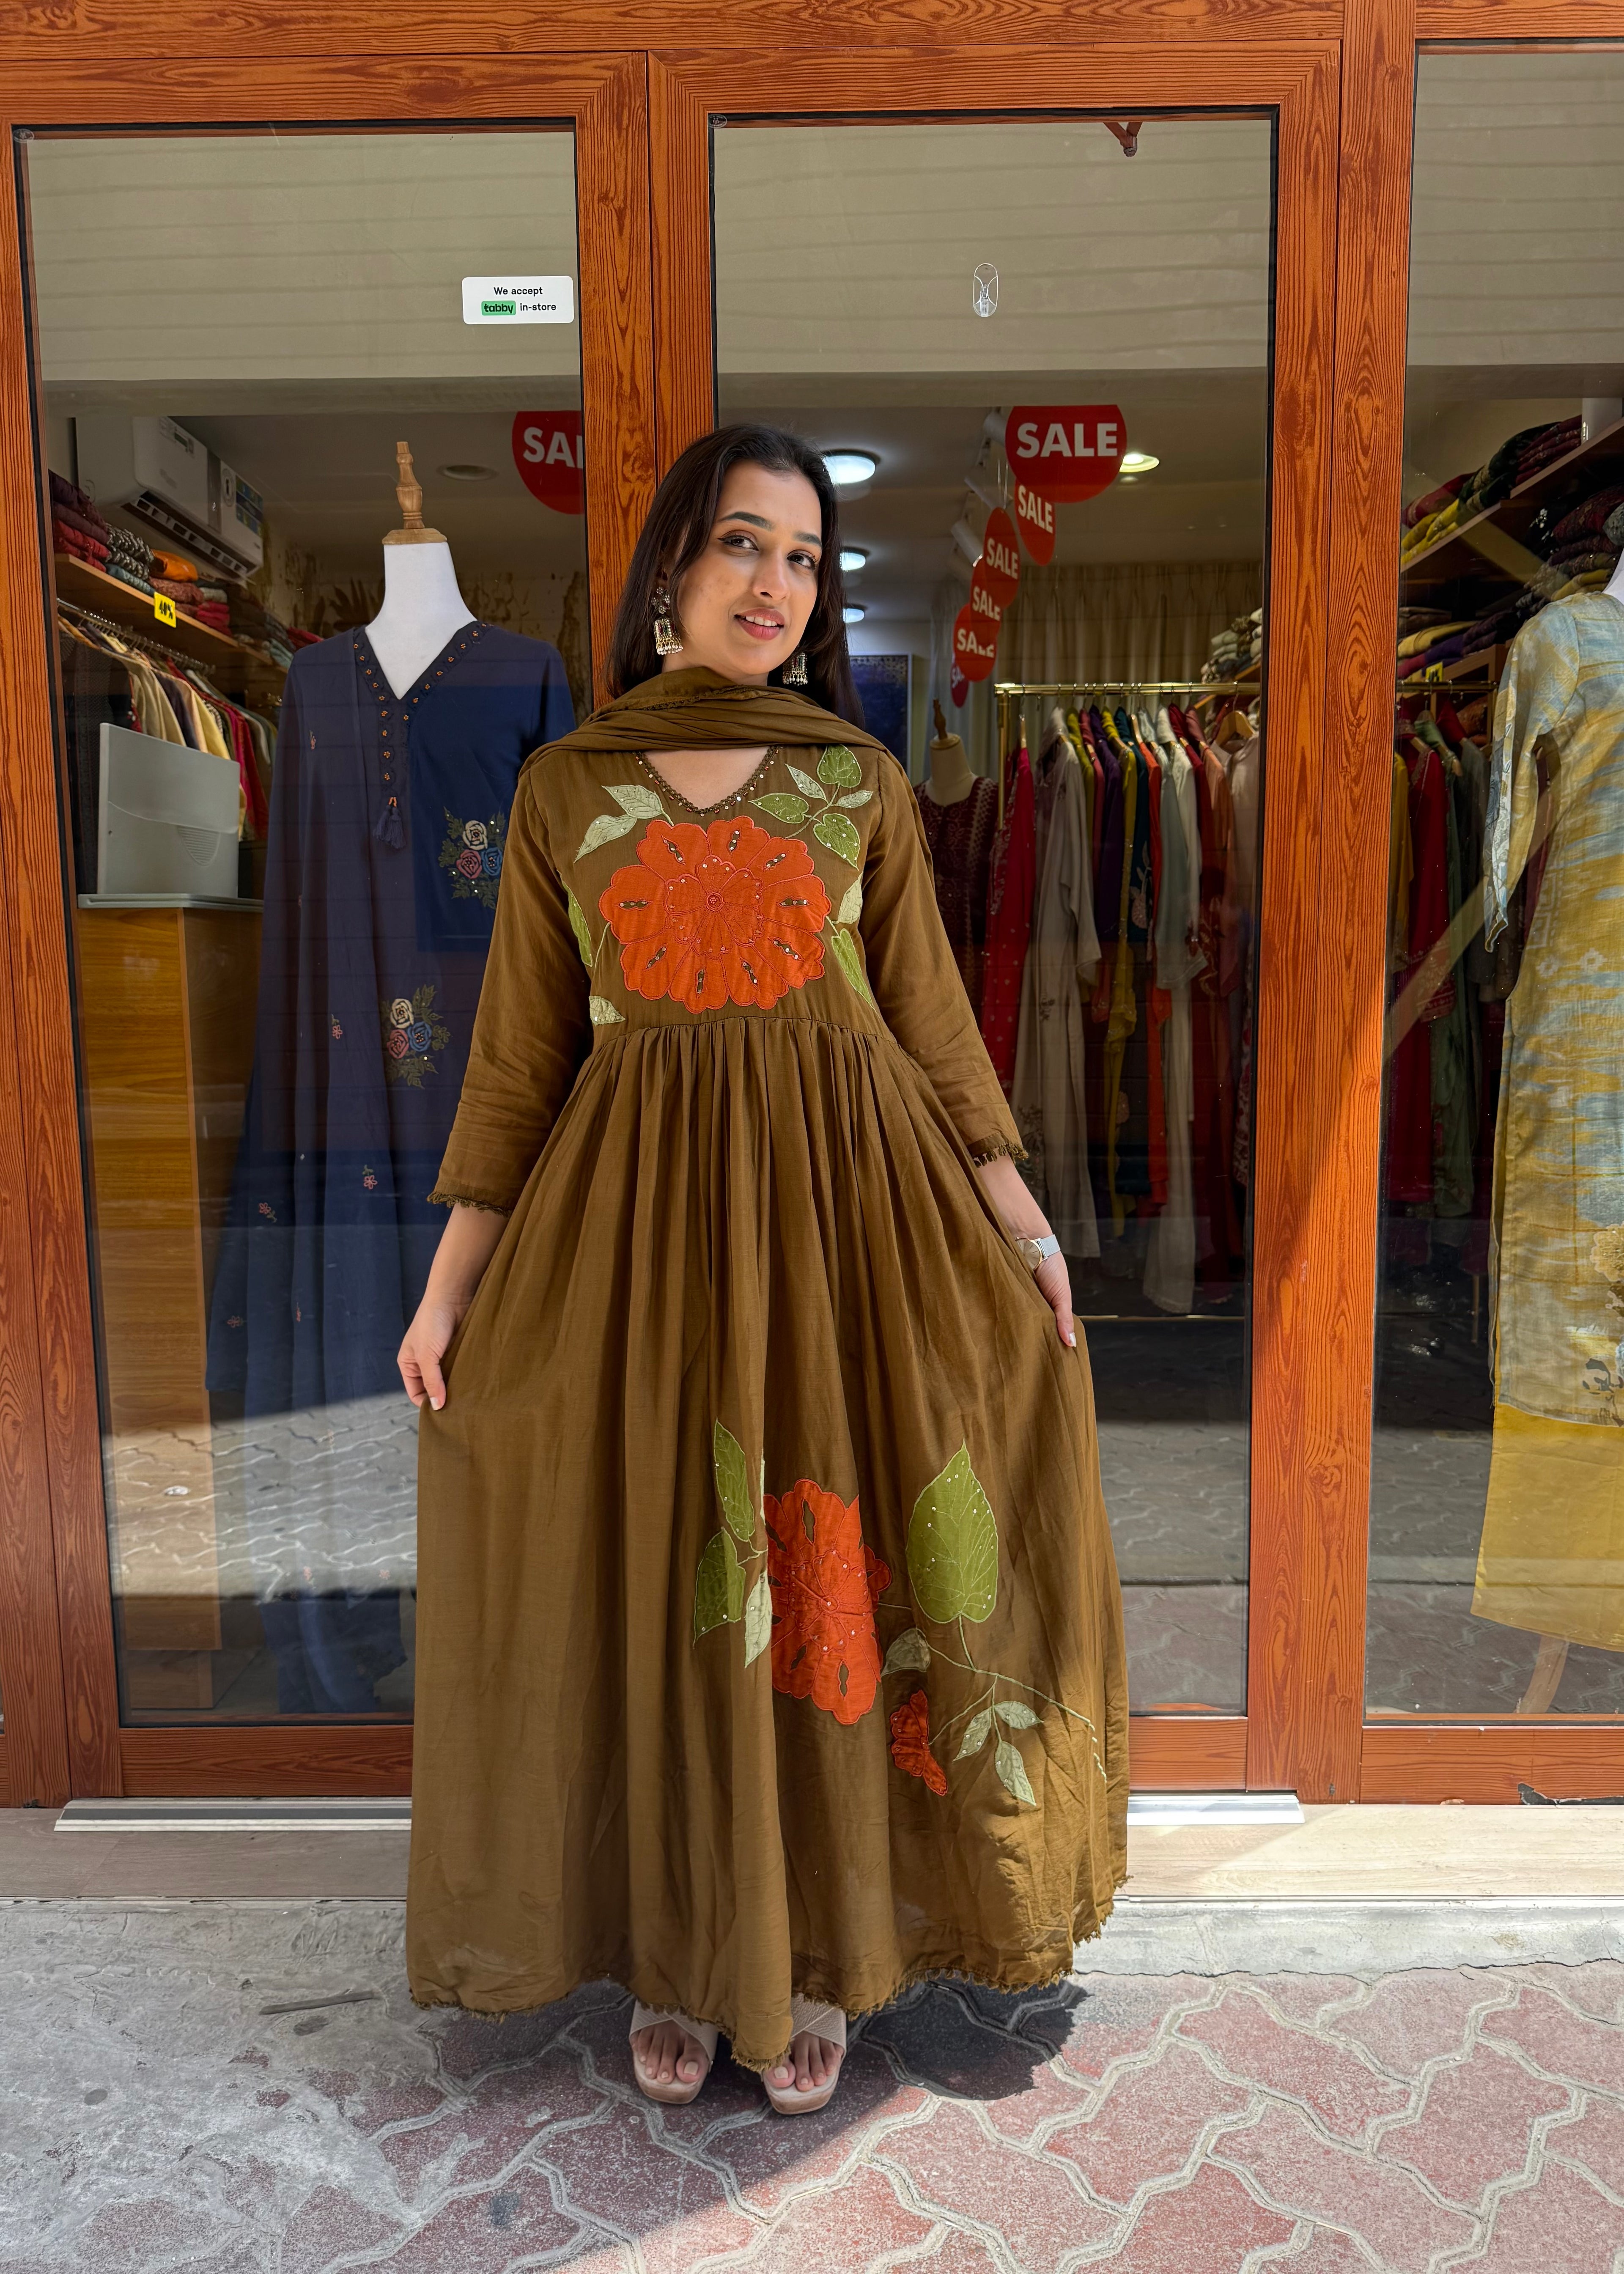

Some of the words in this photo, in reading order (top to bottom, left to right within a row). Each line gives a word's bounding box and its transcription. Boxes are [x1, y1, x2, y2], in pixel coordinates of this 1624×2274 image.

[484, 303, 513, 314] tabby
[520, 303, 557, 311] in-store
[494, 287, 508, 295] We
[511, 287, 543, 297] accept
[1016, 422, 1117, 458] SALE
[1018, 484, 1053, 534] SALE
[986, 537, 1018, 579] SALE
